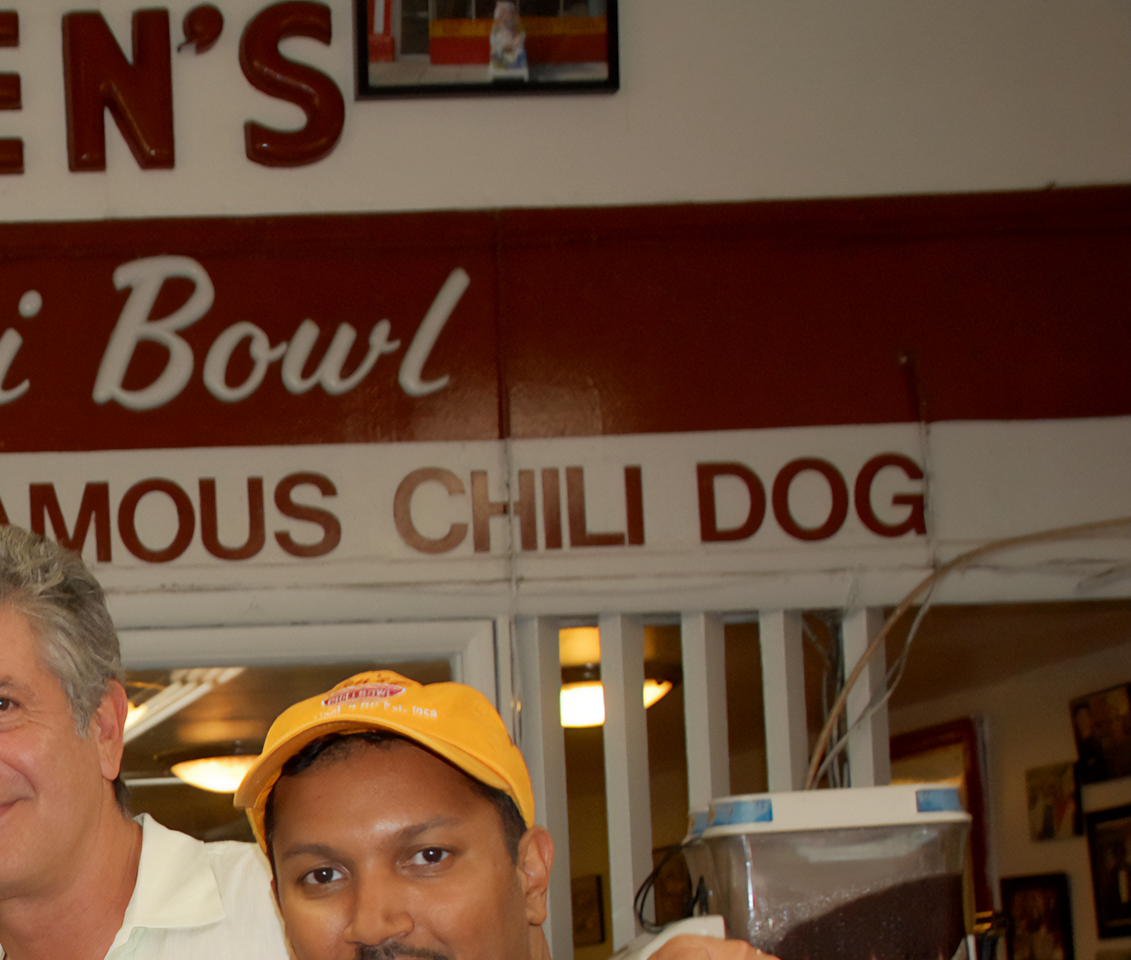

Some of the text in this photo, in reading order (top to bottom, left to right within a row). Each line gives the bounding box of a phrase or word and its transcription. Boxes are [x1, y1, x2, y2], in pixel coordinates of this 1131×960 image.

[92, 255, 471, 412] Bowl
[393, 465, 645, 553] CHILI
[695, 452, 927, 543] DOG
